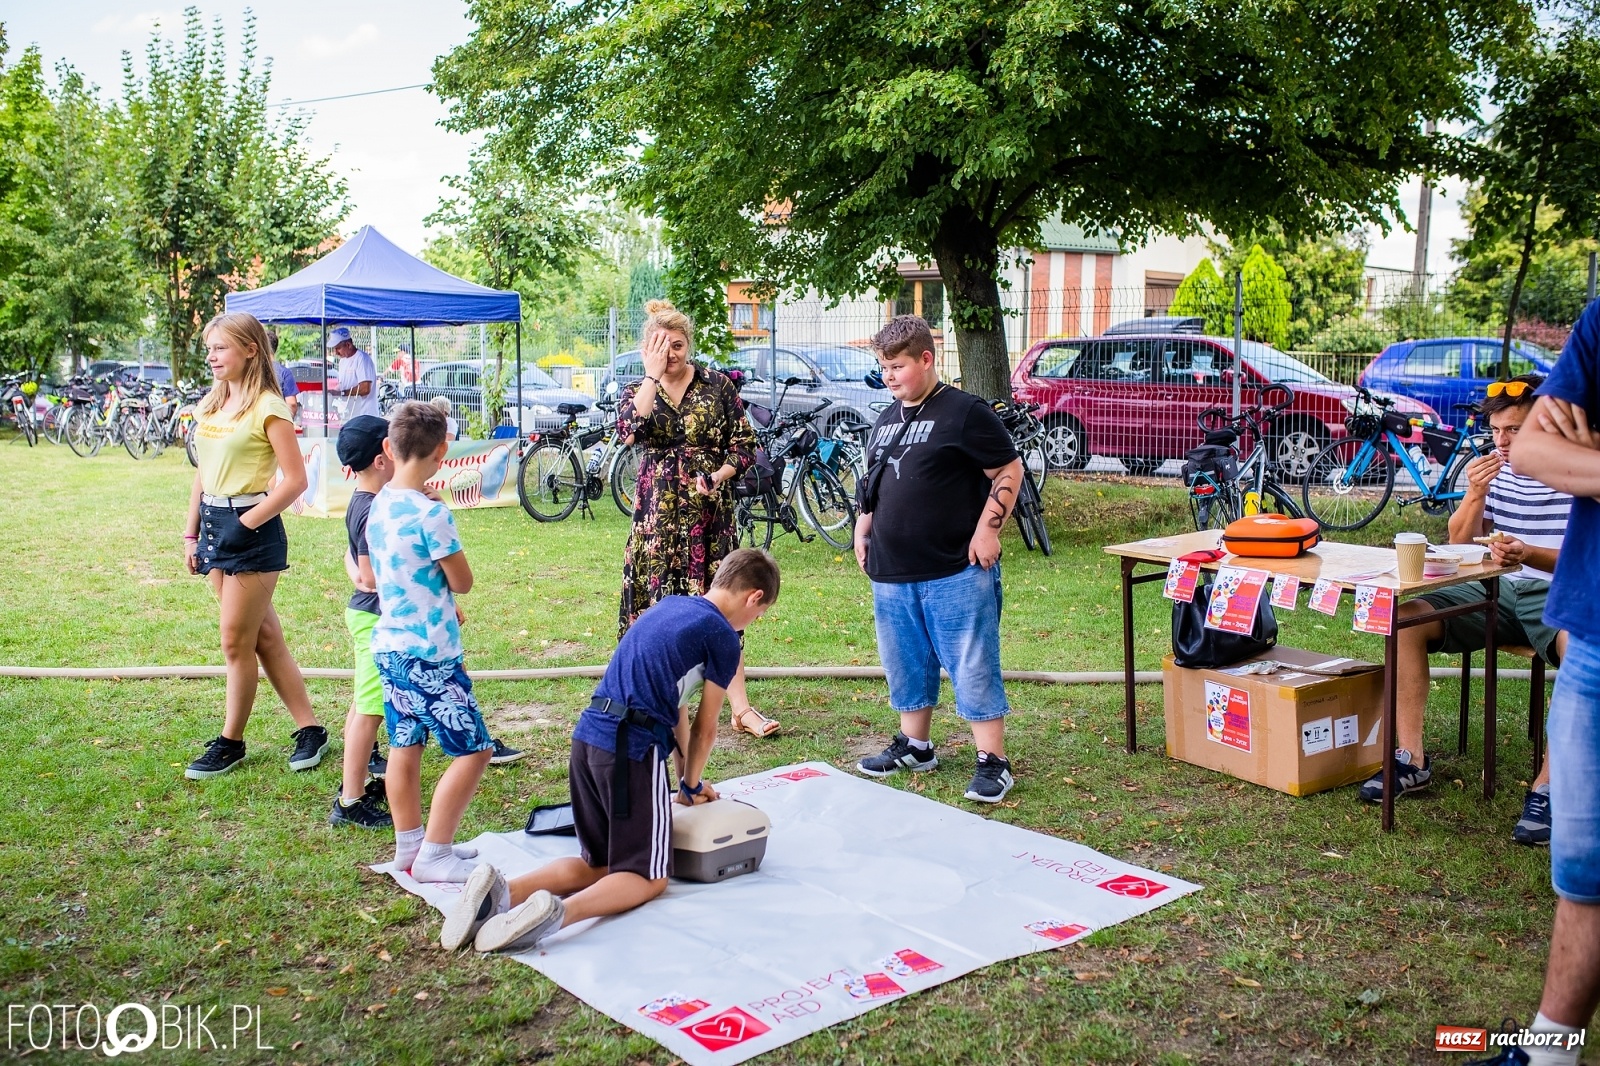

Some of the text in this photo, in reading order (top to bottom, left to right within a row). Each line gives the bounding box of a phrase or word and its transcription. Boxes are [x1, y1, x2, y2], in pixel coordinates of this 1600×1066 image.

[1012, 851, 1100, 885] PROJEKT
[1073, 859, 1118, 876] AED
[747, 968, 851, 1014] PROJEKT
[771, 1000, 822, 1024] AED
